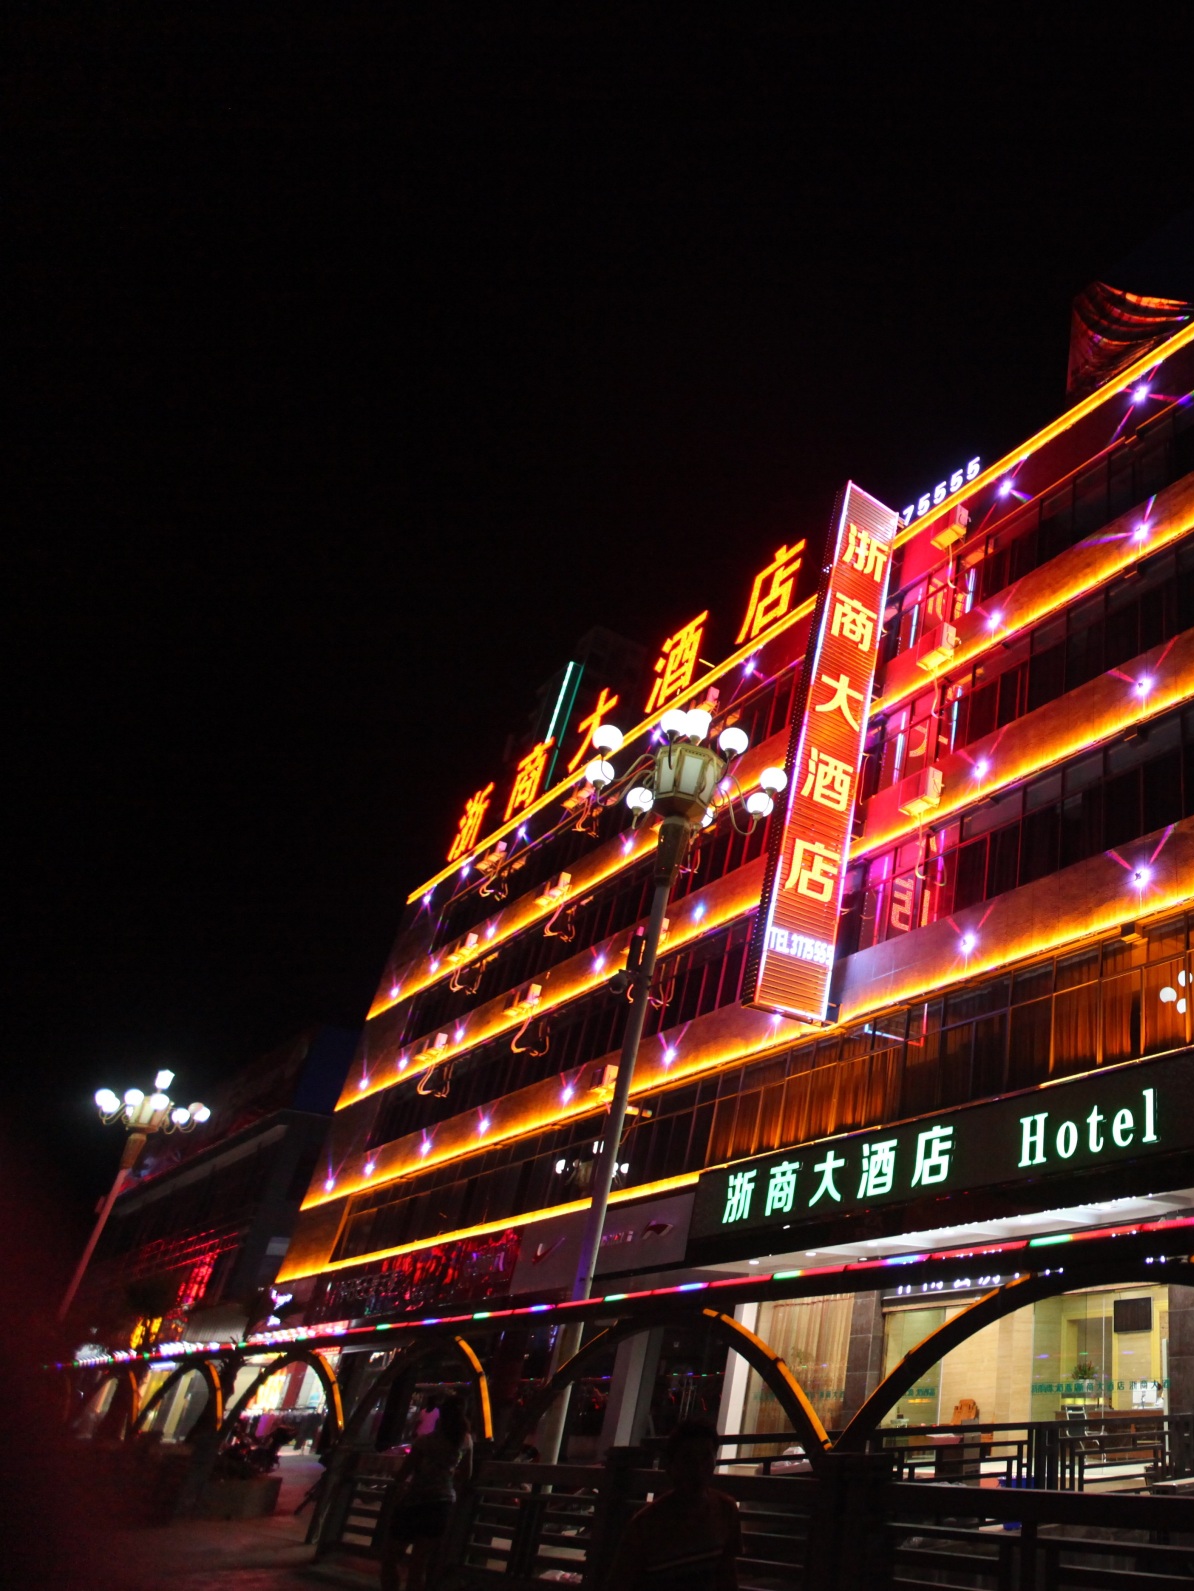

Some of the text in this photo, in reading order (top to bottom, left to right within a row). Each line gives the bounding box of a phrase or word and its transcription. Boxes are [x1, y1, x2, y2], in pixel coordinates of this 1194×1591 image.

[446, 538, 806, 863] 浙商大酒店
[784, 522, 887, 904] 浙商大酒店
[722, 1087, 1160, 1225] 浙商大酒店 Hotel
